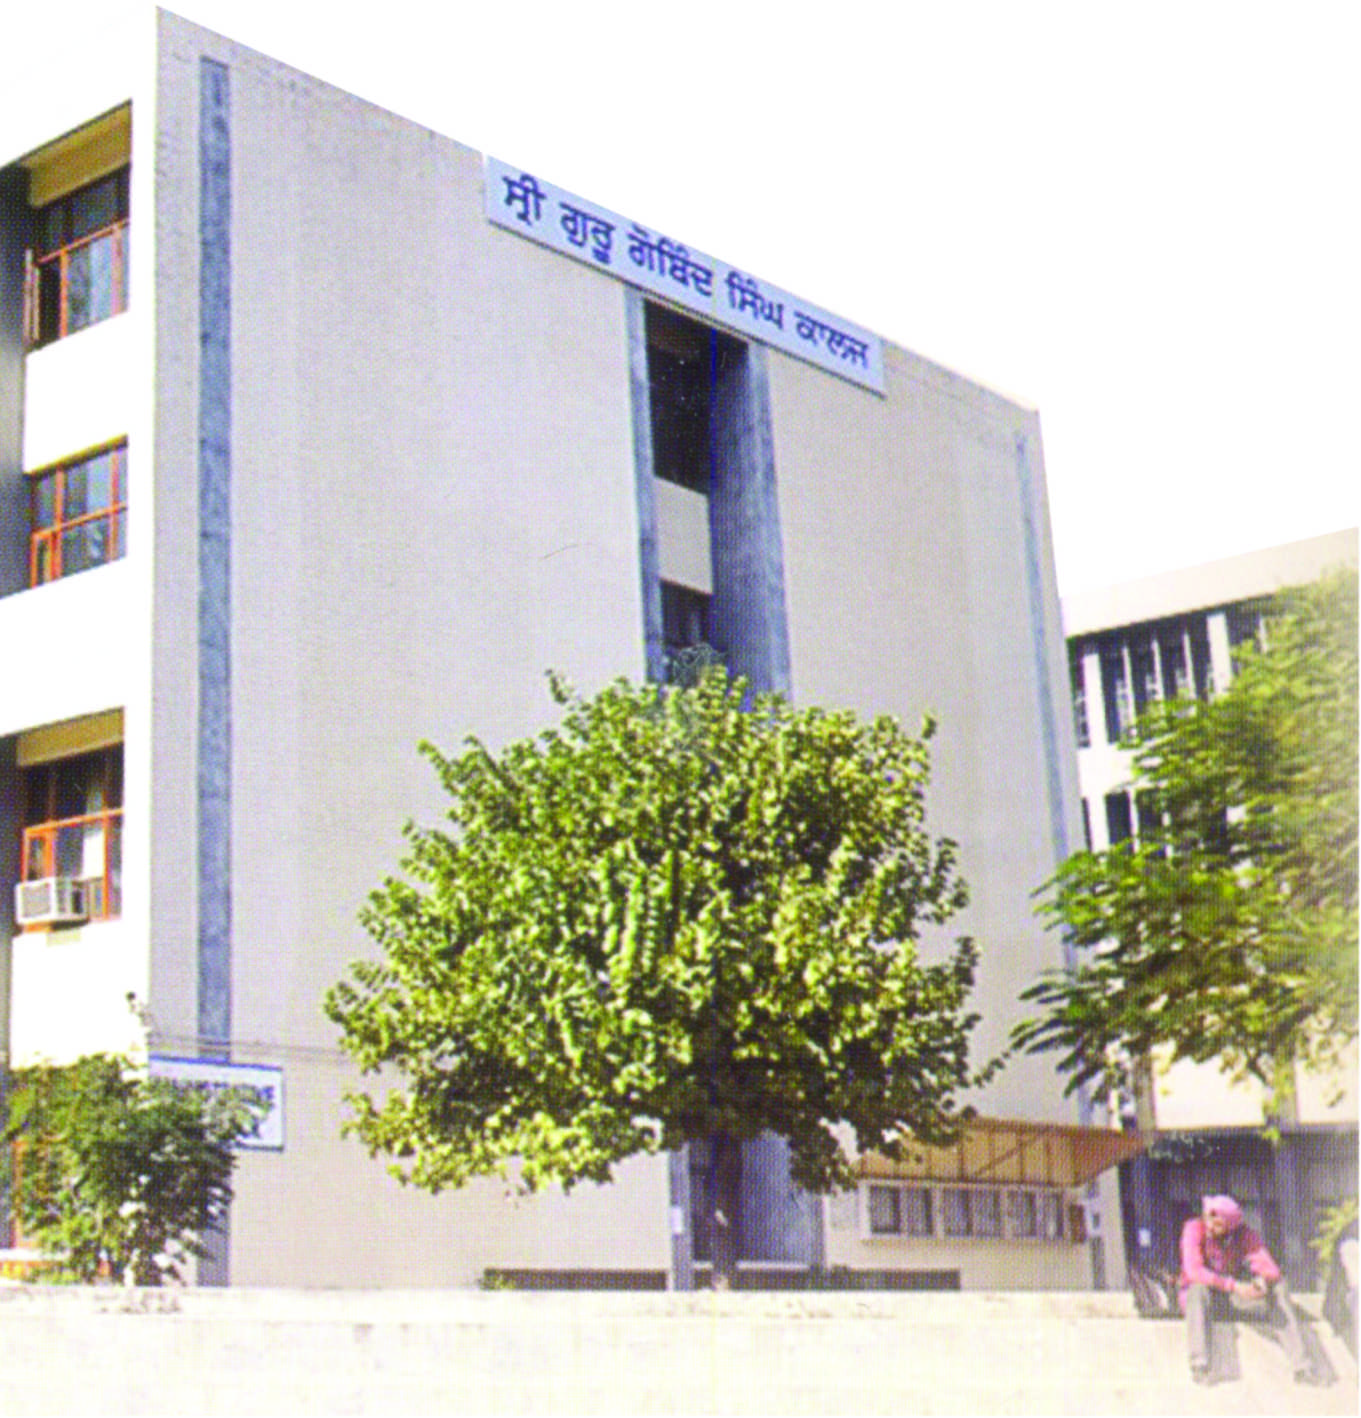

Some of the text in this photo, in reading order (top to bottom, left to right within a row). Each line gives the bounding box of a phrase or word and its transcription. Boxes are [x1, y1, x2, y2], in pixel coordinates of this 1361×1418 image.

[501, 173, 870, 370] ਸ੍ਰੀ ਗੁਰੂ ਗੋਬਿੰਦ ਸਿੰਘ ਕਾਲਜ
